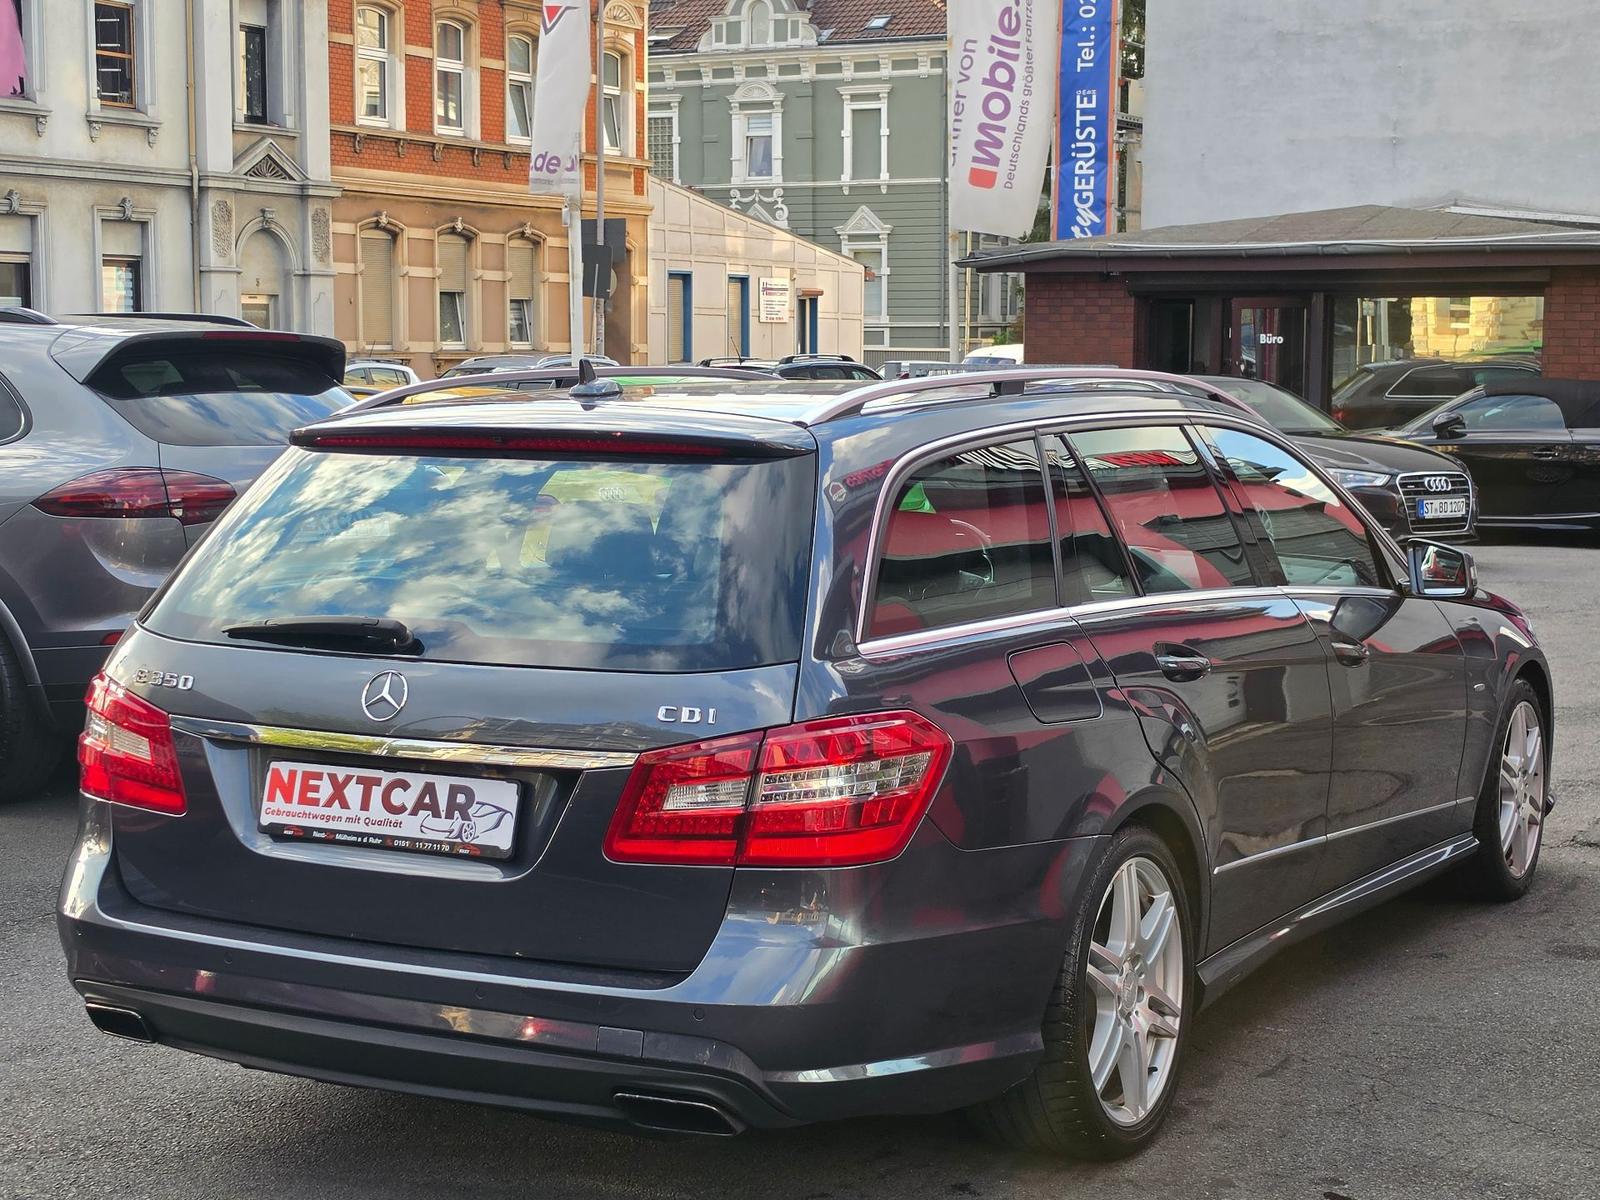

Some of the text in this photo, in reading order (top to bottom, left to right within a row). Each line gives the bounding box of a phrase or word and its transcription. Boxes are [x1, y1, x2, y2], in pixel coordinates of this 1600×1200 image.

[957, 39, 978, 84] von
[1077, 26, 1096, 72] Tel.:
[1004, 100, 1030, 190] Deutschlands
[1022, 47, 1034, 97] größter
[1259, 333, 1284, 344] Büro
[1424, 502, 1434, 514] ST
[657, 705, 717, 724] CDI
[266, 767, 476, 822] NEXTCAR
[264, 807, 403, 829] Gebrauchtwagen mit Qualität
